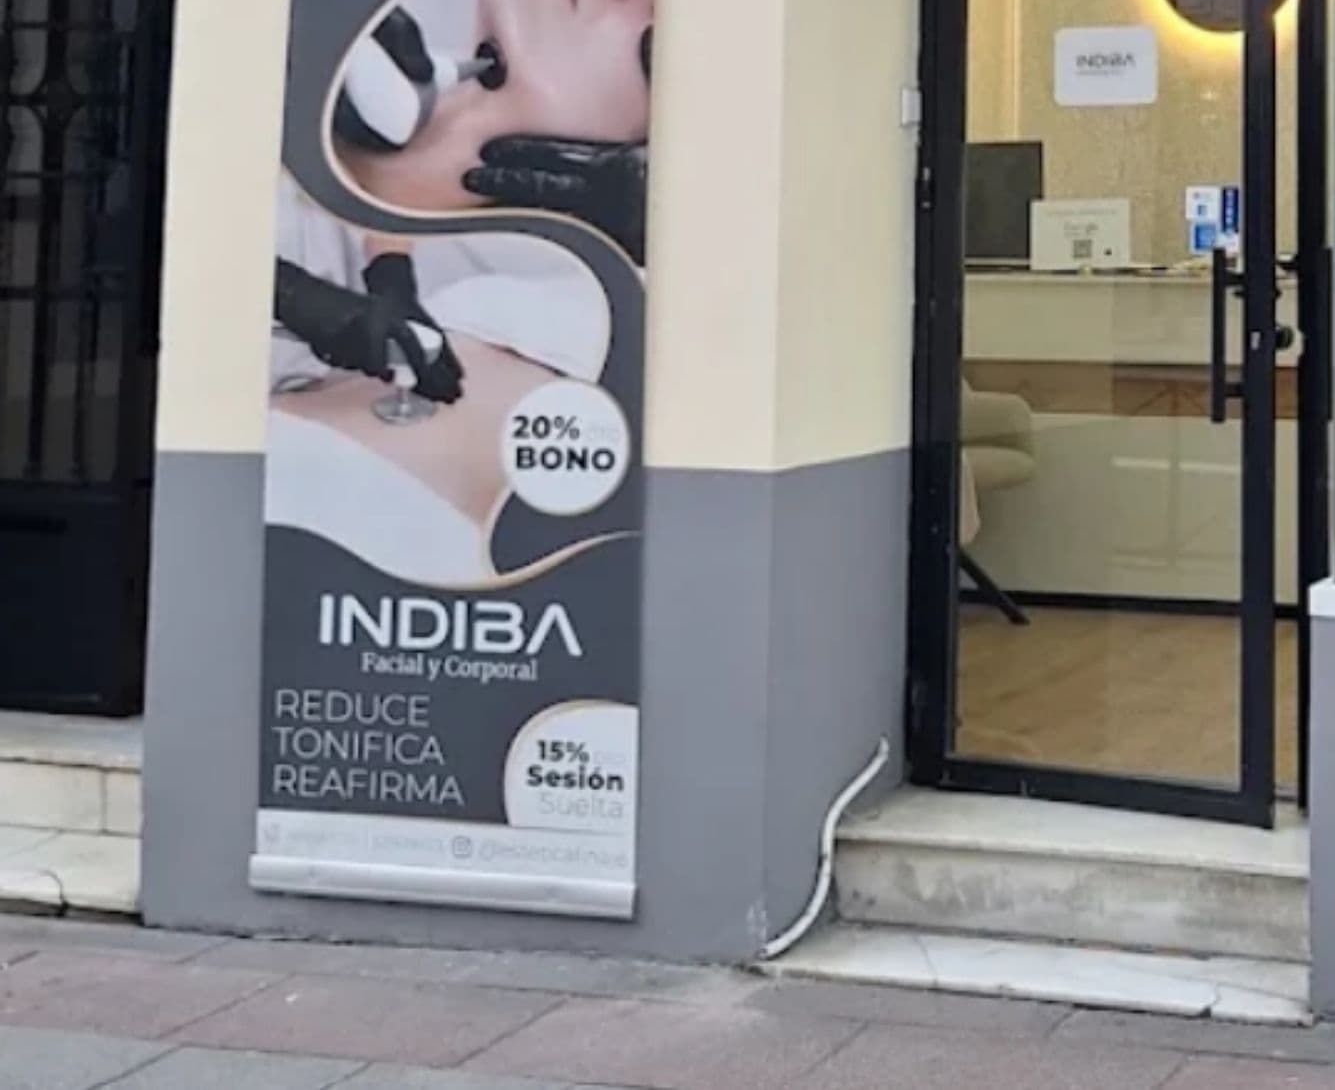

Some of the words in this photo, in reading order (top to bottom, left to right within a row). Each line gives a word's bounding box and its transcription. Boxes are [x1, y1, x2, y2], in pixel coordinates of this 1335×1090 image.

[512, 415, 581, 440] 20%
[515, 446, 616, 471] BONO
[319, 593, 583, 656] INDIBA
[360, 652, 424, 676] Facial
[427, 660, 441, 679] y
[444, 655, 538, 683] Corporal
[275, 688, 431, 727] REDUCE
[272, 725, 444, 766] TONIFICA
[537, 738, 590, 762] 15%
[272, 764, 464, 806] REAFIRMA
[526, 765, 624, 791] Sesión
[538, 791, 625, 819] Suelta
